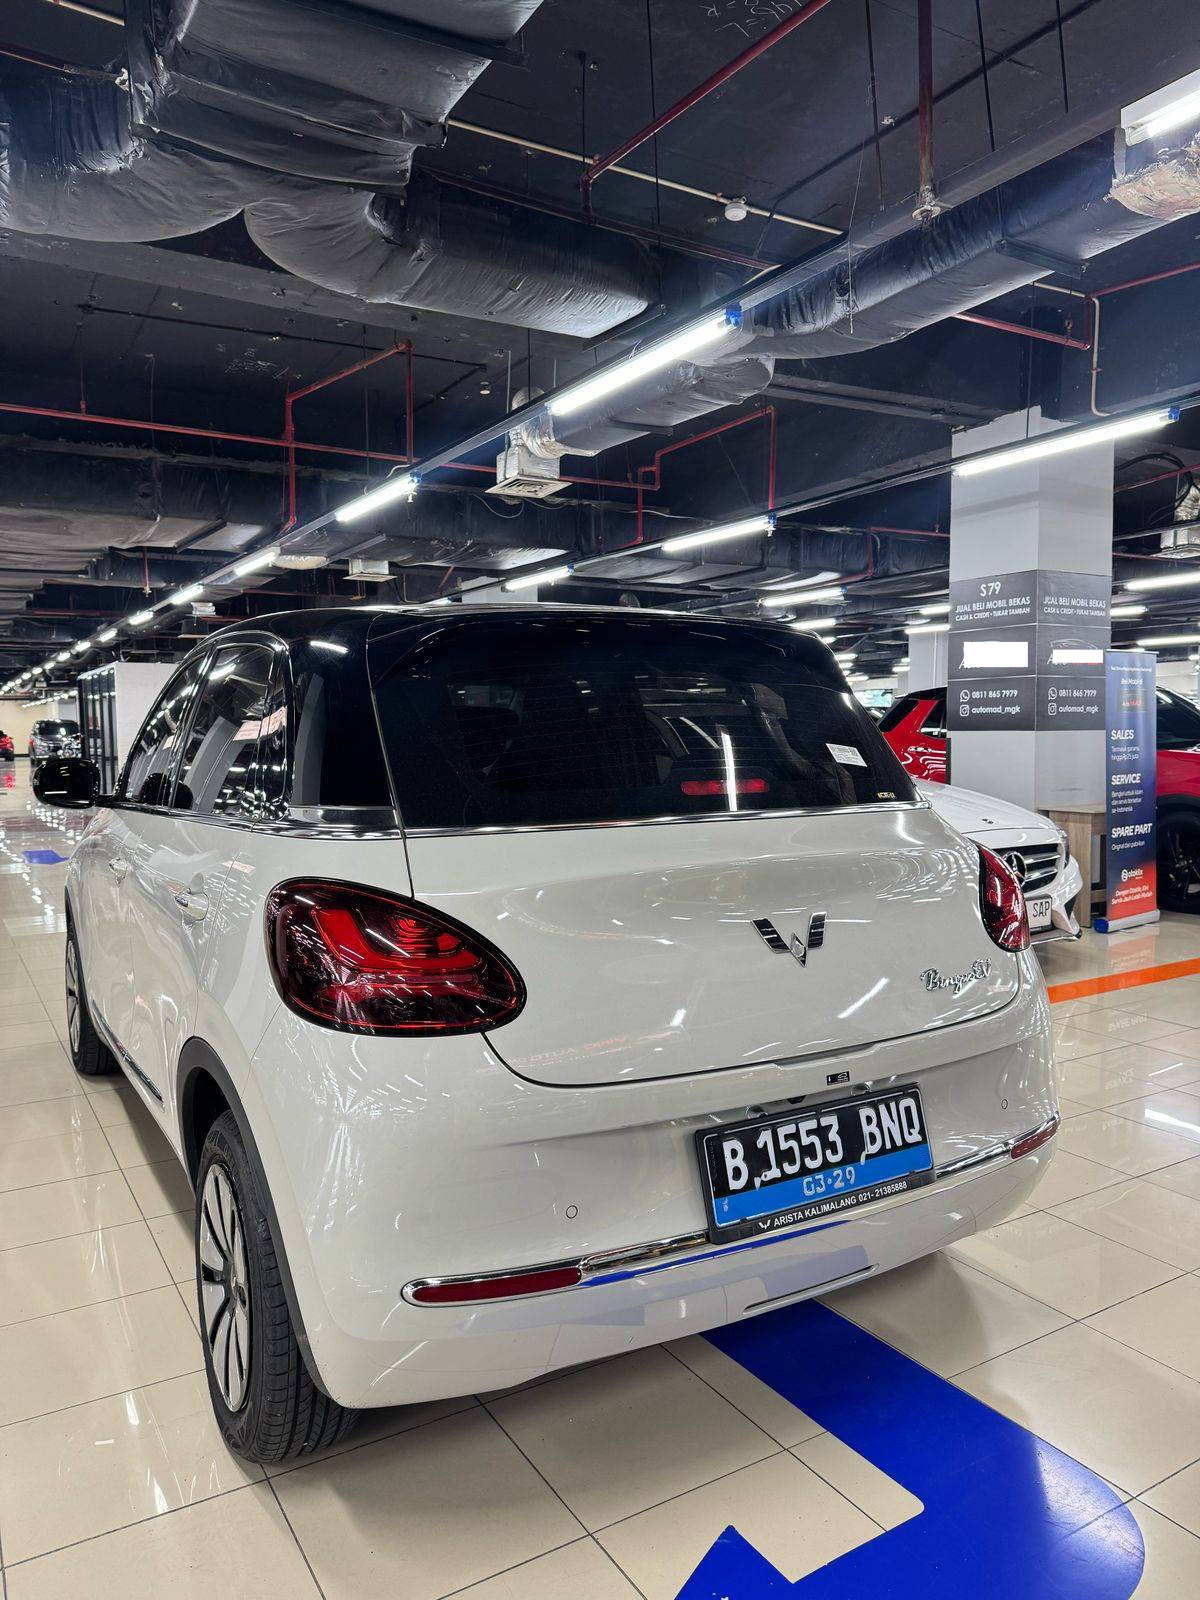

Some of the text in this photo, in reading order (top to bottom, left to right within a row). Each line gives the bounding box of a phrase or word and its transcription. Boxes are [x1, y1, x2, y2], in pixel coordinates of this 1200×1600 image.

[980, 581, 1001, 597] S79
[955, 596, 1031, 613] JUAL BELI MOBIL BEKAS
[1043, 596, 1106, 608] JUAL BELI MOBIL BEKAS
[955, 614, 969, 622] CASH
[974, 611, 990, 620] CREDIT
[1009, 607, 1031, 615] TAMBAH
[1043, 606, 1056, 614] CASH
[971, 689, 1018, 699] 0811 865 7979
[1072, 689, 1083, 697] 865
[1083, 689, 1097, 697] 7979
[971, 704, 1021, 714] automad_mgk
[1058, 705, 1099, 714] automad_mgk
[1111, 729, 1135, 740] SALES
[1111, 773, 1142, 786] SERVICE
[1111, 822, 1153, 839] SPARE PART
[1032, 900, 1050, 918] SAP
[722, 1137, 750, 1191] B
[756, 1114, 844, 1183] 1553
[859, 1098, 923, 1155] BNQ
[773, 1211, 804, 1228] ARISTA
[804, 1197, 857, 1218] KALIMALANG
[874, 1181, 908, 1198] 21385888
